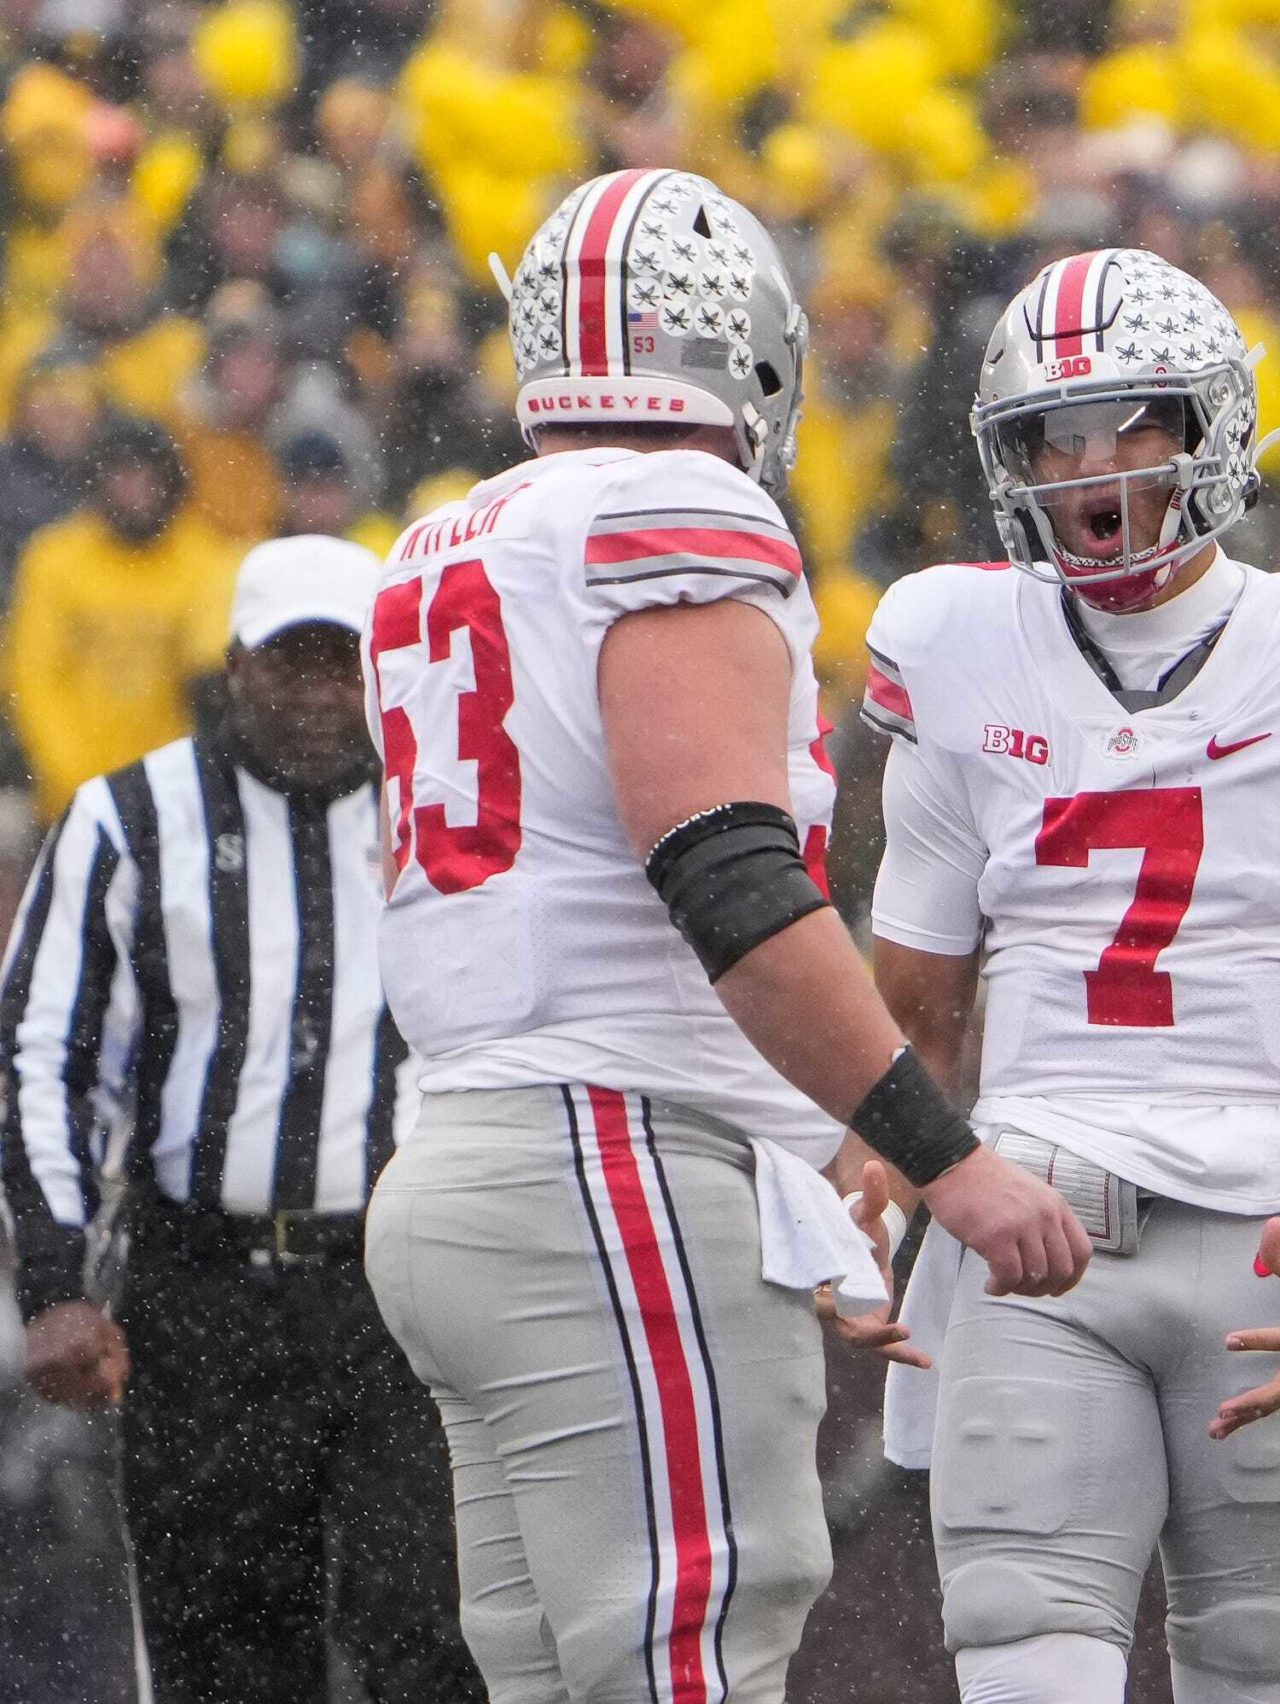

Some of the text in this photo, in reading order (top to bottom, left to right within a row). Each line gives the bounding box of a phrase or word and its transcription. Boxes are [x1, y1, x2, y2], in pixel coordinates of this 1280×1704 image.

[528, 395, 685, 412] BUCKEYES
[634, 336, 655, 353] 53
[371, 559, 522, 895] 53
[1034, 786, 1205, 1027] 7
